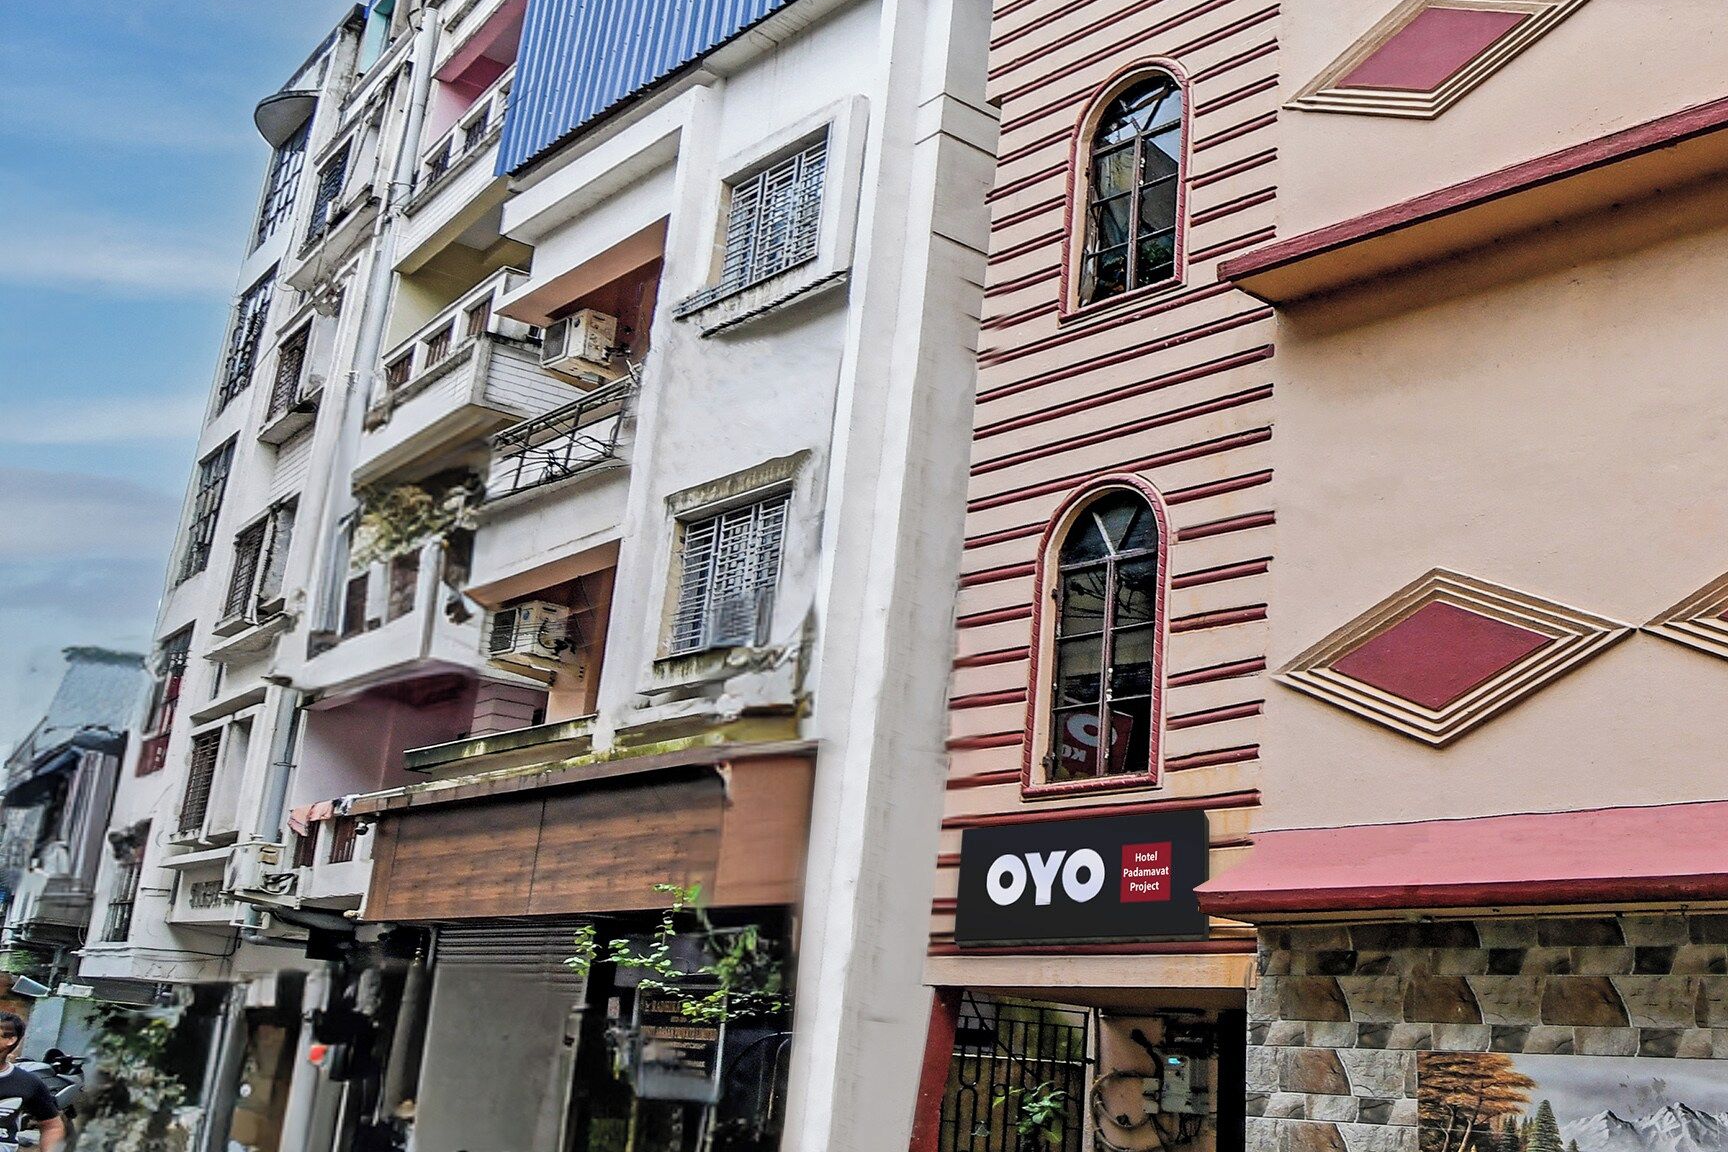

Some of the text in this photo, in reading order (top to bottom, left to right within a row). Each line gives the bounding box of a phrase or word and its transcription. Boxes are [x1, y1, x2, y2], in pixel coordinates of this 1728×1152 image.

[1135, 851, 1158, 862] Hotel
[986, 848, 1106, 906] OYO
[1123, 866, 1169, 877] Padamavat
[1129, 882, 1160, 894] Project
